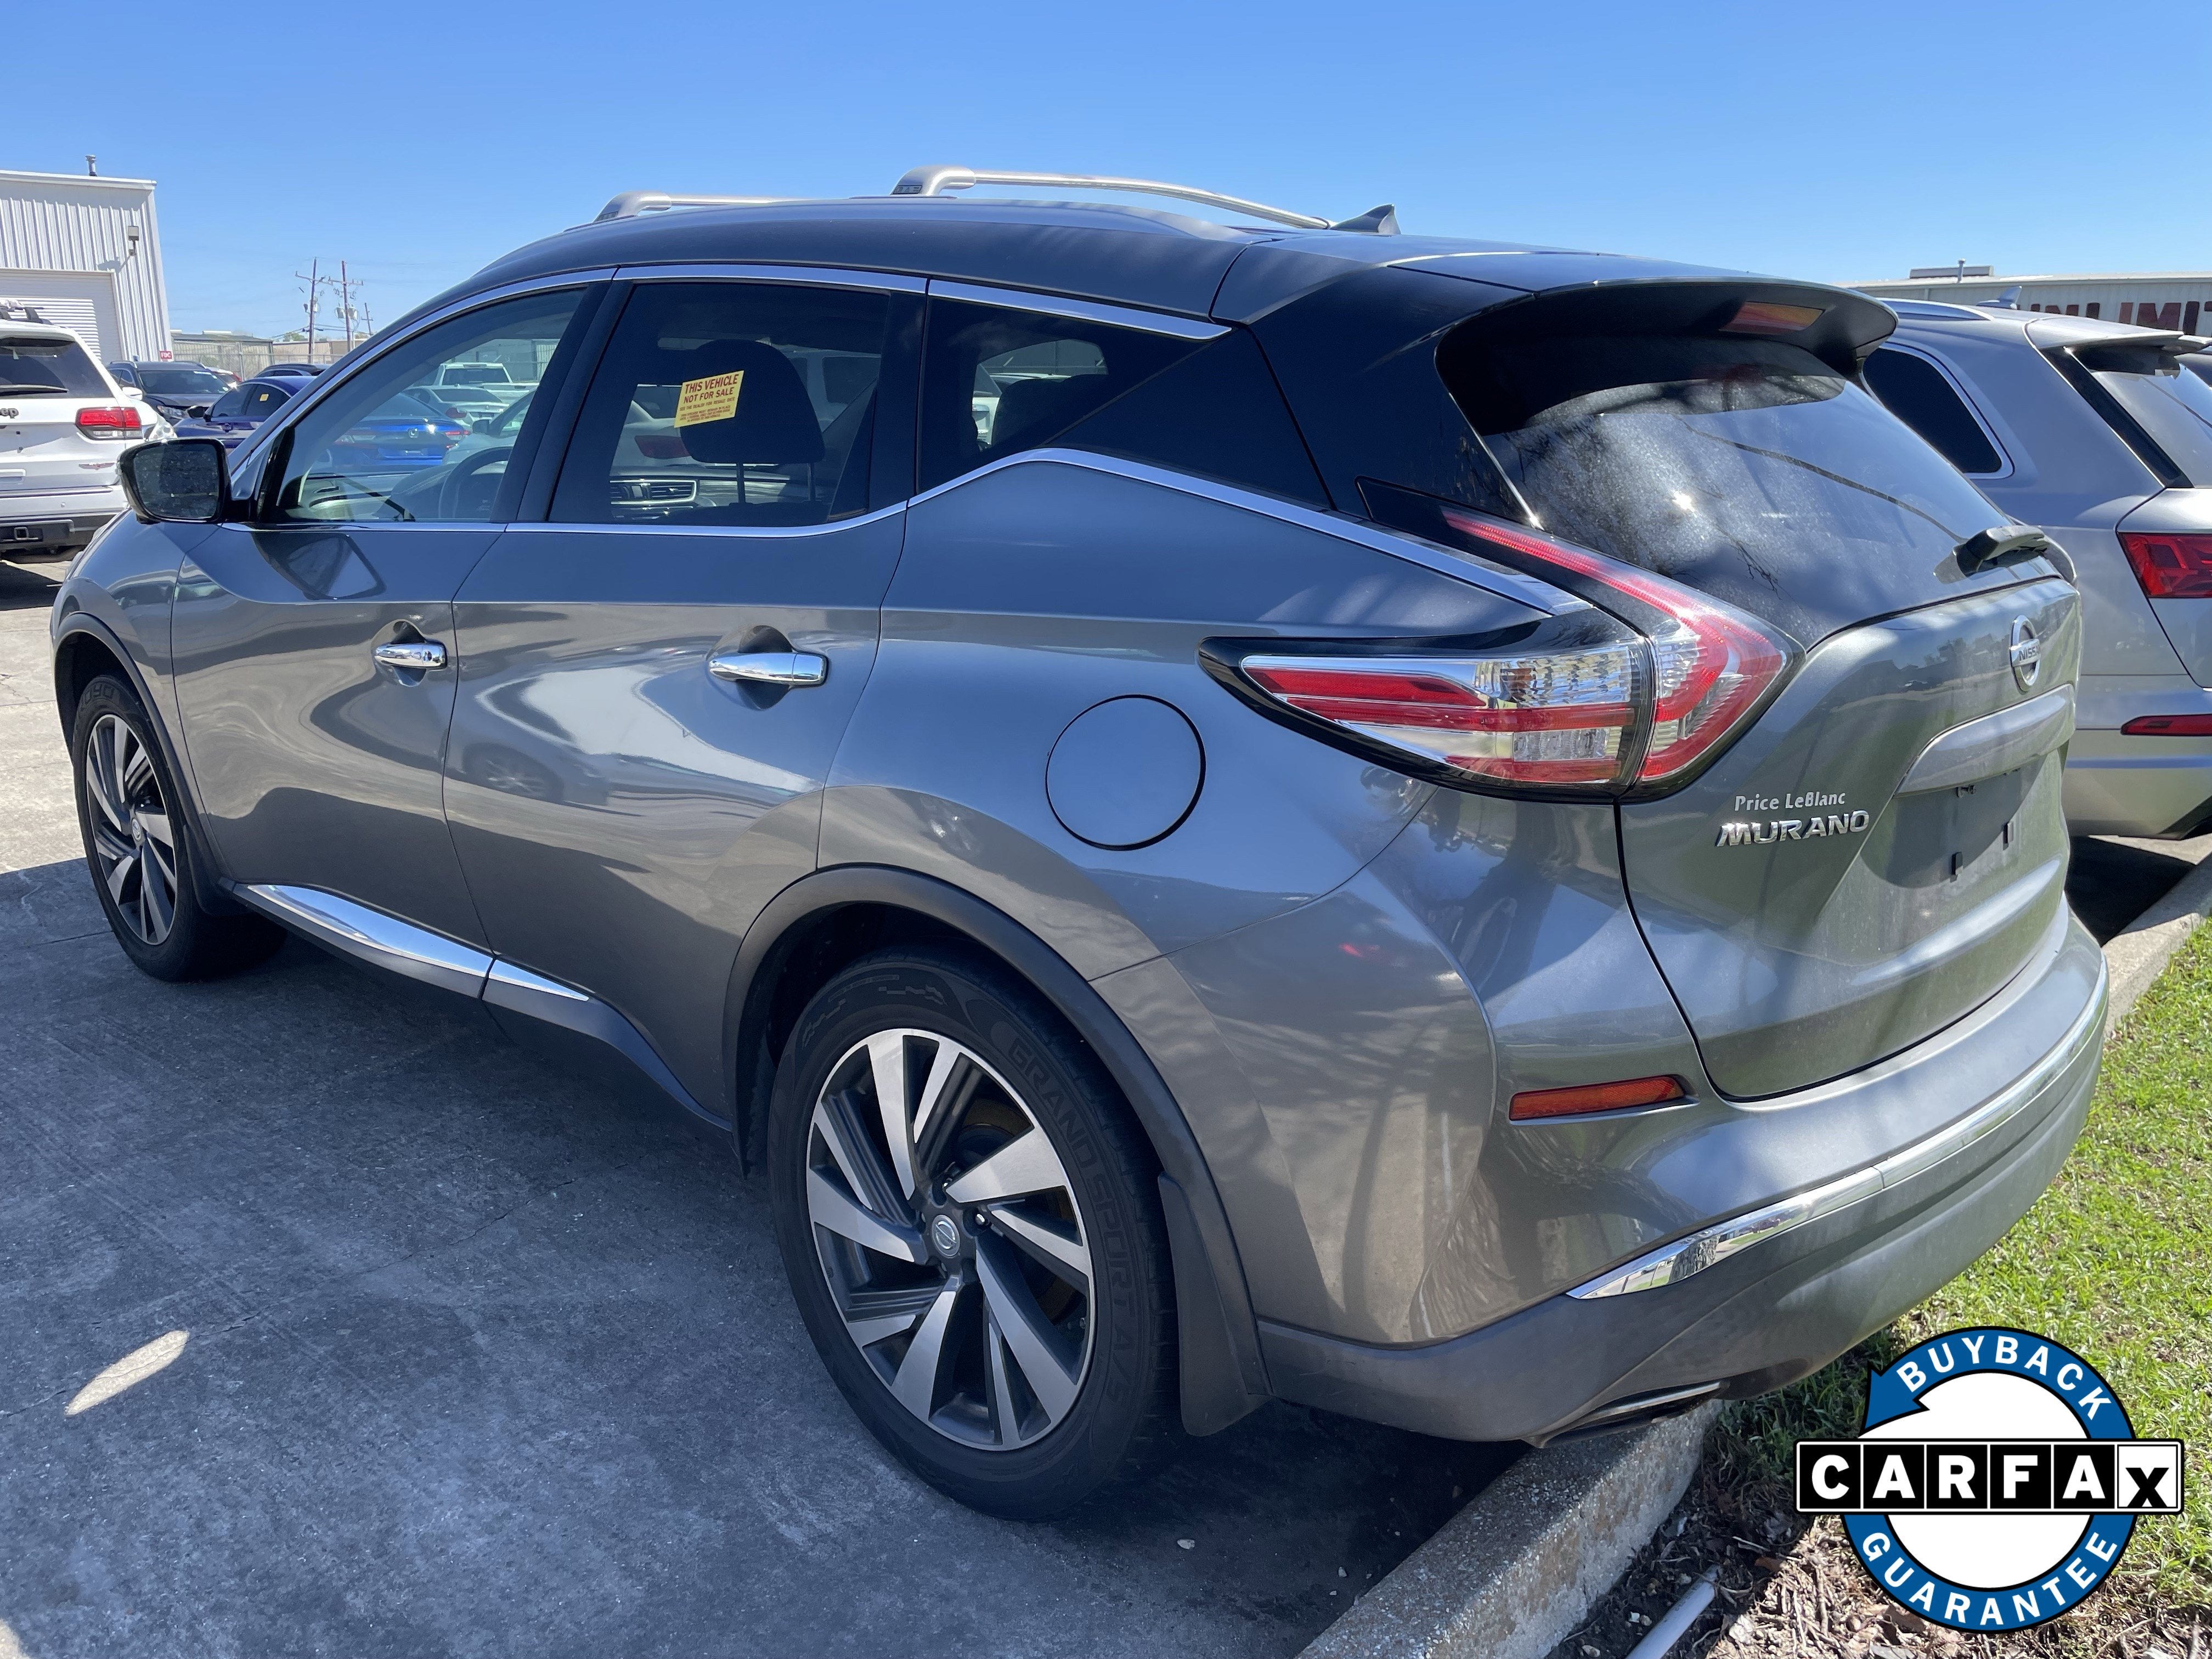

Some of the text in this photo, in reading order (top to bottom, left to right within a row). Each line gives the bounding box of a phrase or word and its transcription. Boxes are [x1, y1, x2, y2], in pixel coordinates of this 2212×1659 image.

[685, 374, 739, 394] THIS VEHICLE
[684, 387, 734, 404] NOT FOR SALE
[1735, 791, 1846, 811] Price LeBlanc
[1715, 810, 1869, 847] MURANO
[1008, 1041, 1098, 1169] GRAND
[1090, 1172, 1136, 1321] SPORT
